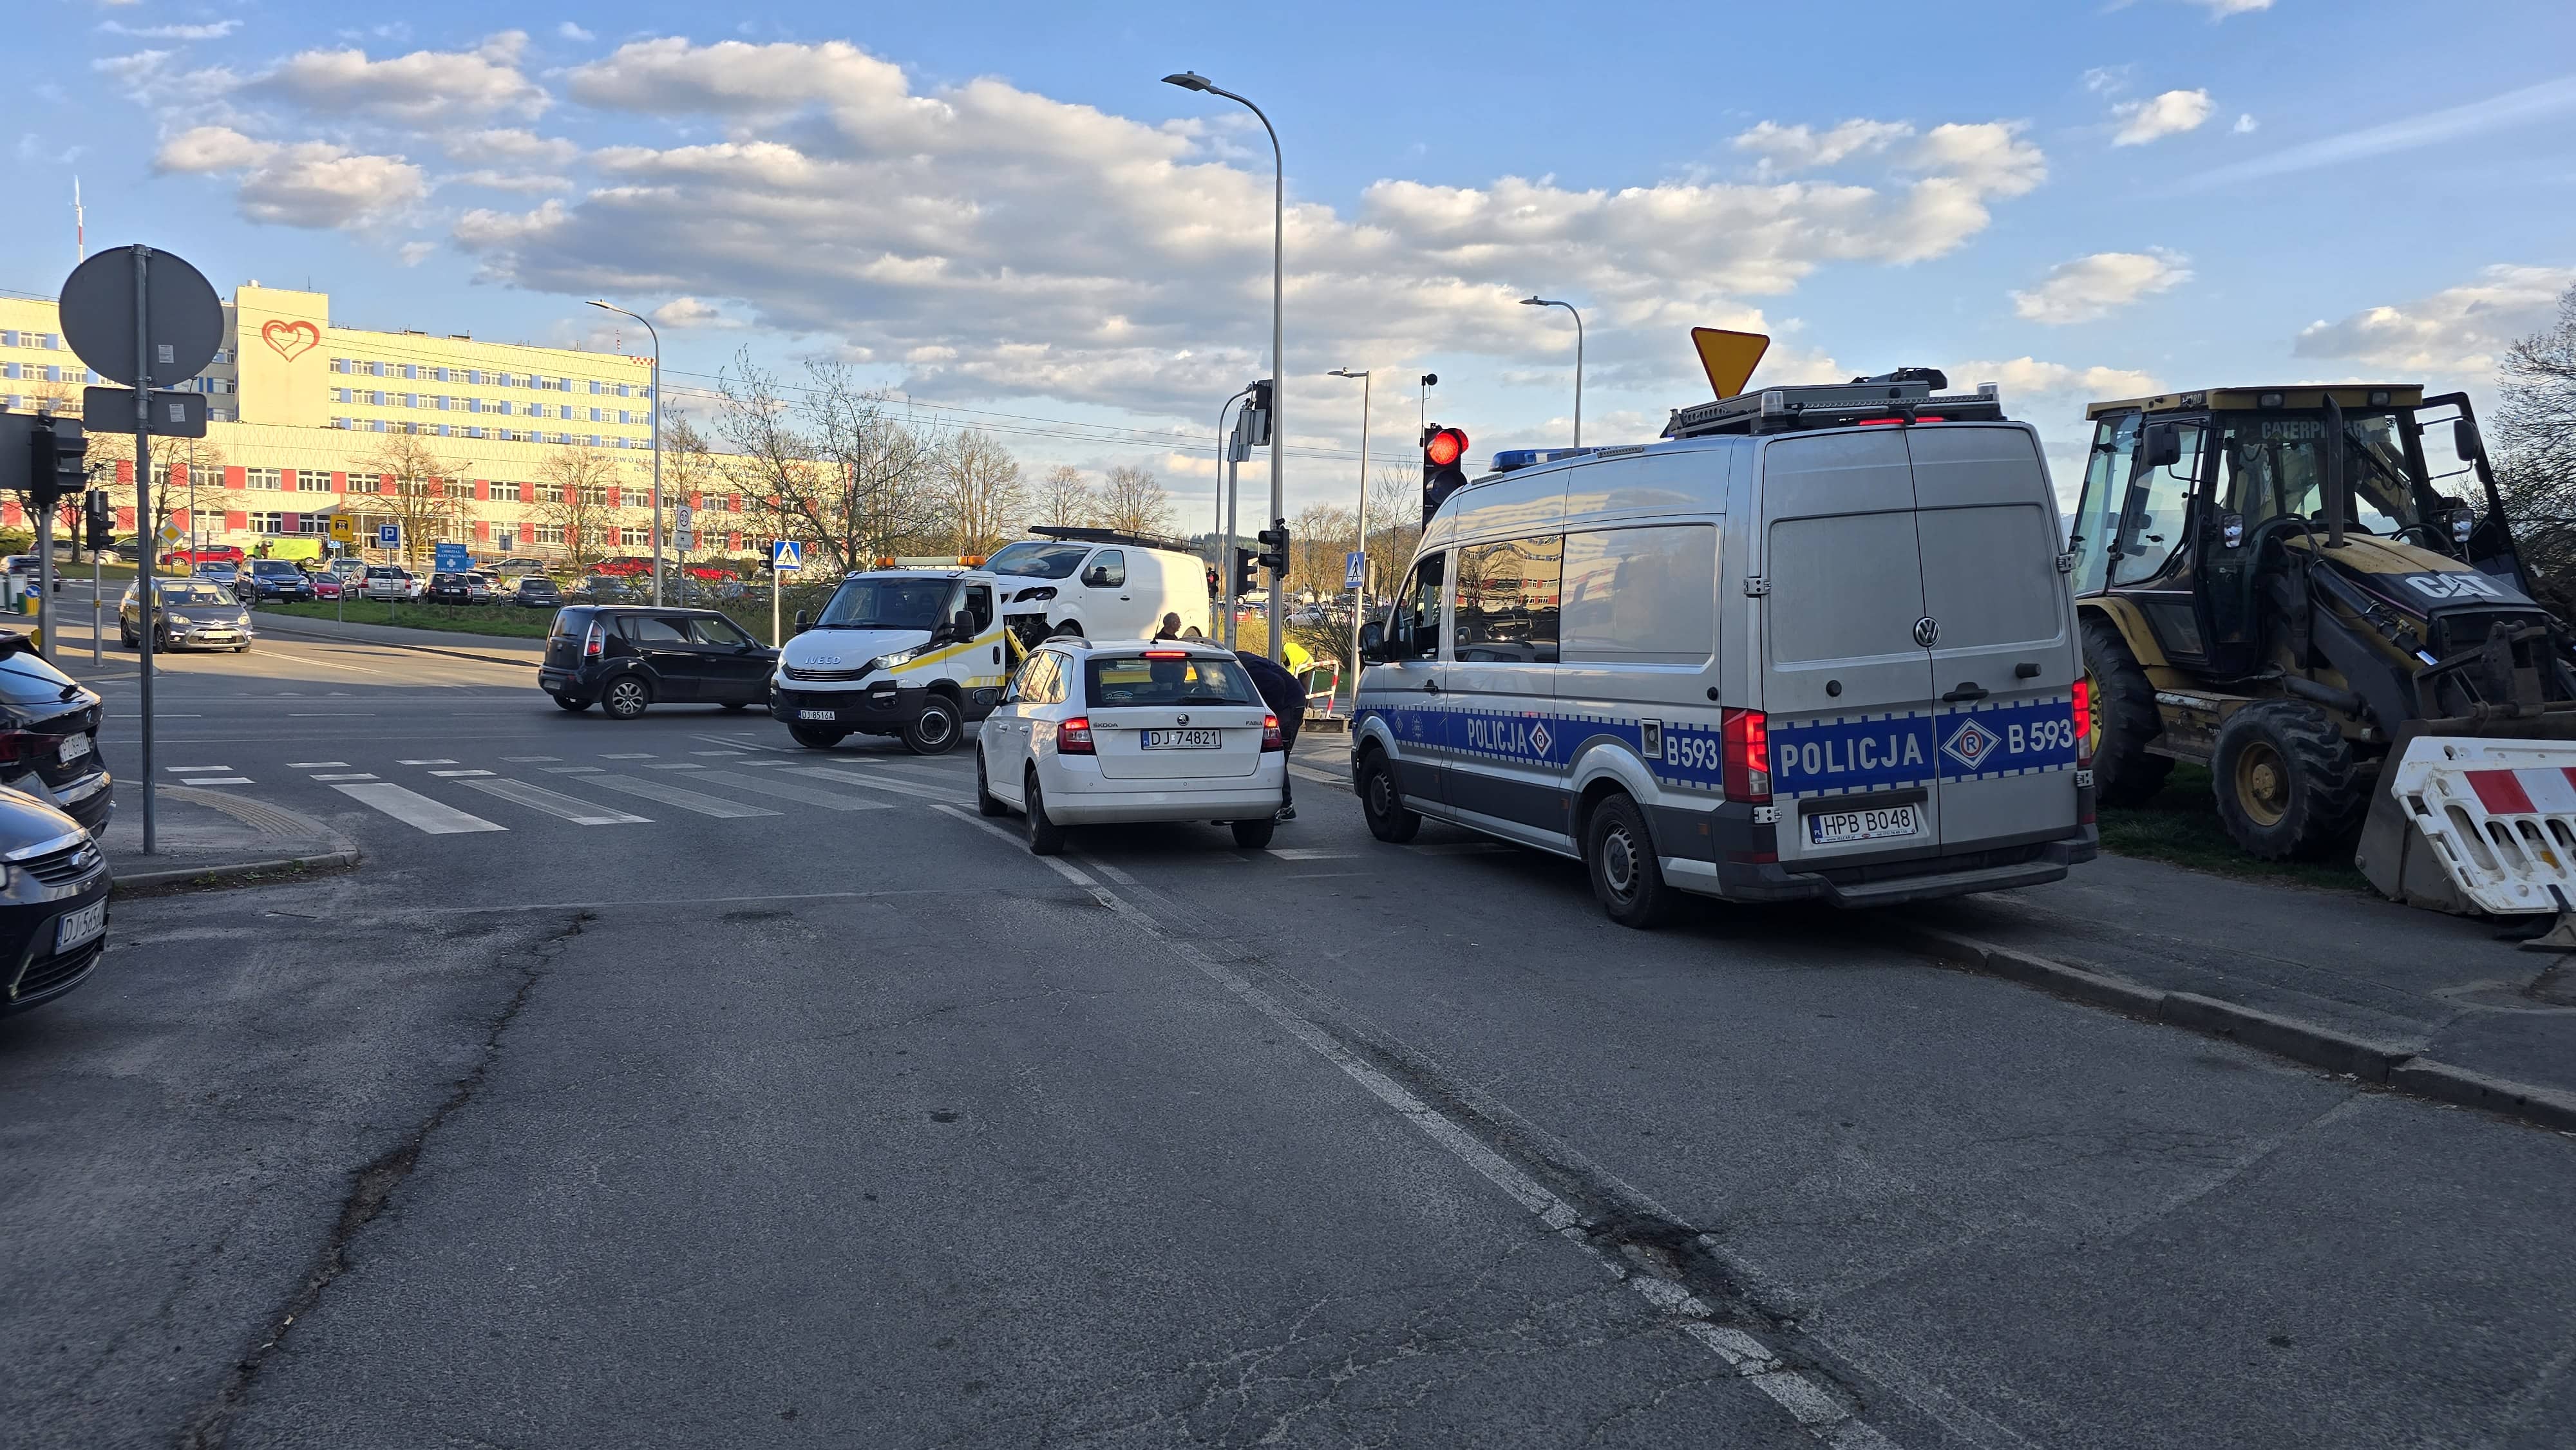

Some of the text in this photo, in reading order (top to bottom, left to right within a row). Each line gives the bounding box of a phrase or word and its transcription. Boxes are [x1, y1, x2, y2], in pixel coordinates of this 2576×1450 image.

[2262, 421, 2362, 439] CATERPIAR
[591, 455, 665, 466] WOJEWÓDZKE
[384, 528, 394, 540] P
[2405, 574, 2504, 598] CAT
[805, 655, 841, 664] IVECO
[802, 711, 833, 720] DJ 8516A
[1151, 731, 1217, 745] DJ 74821
[1467, 719, 1529, 755] POLICJA
[2008, 719, 2074, 753] B 593
[1667, 736, 1718, 770] B 593
[1780, 733, 1924, 777] POLICJA
[1824, 814, 1860, 836] HPB
[63, 915, 80, 944] DJ
